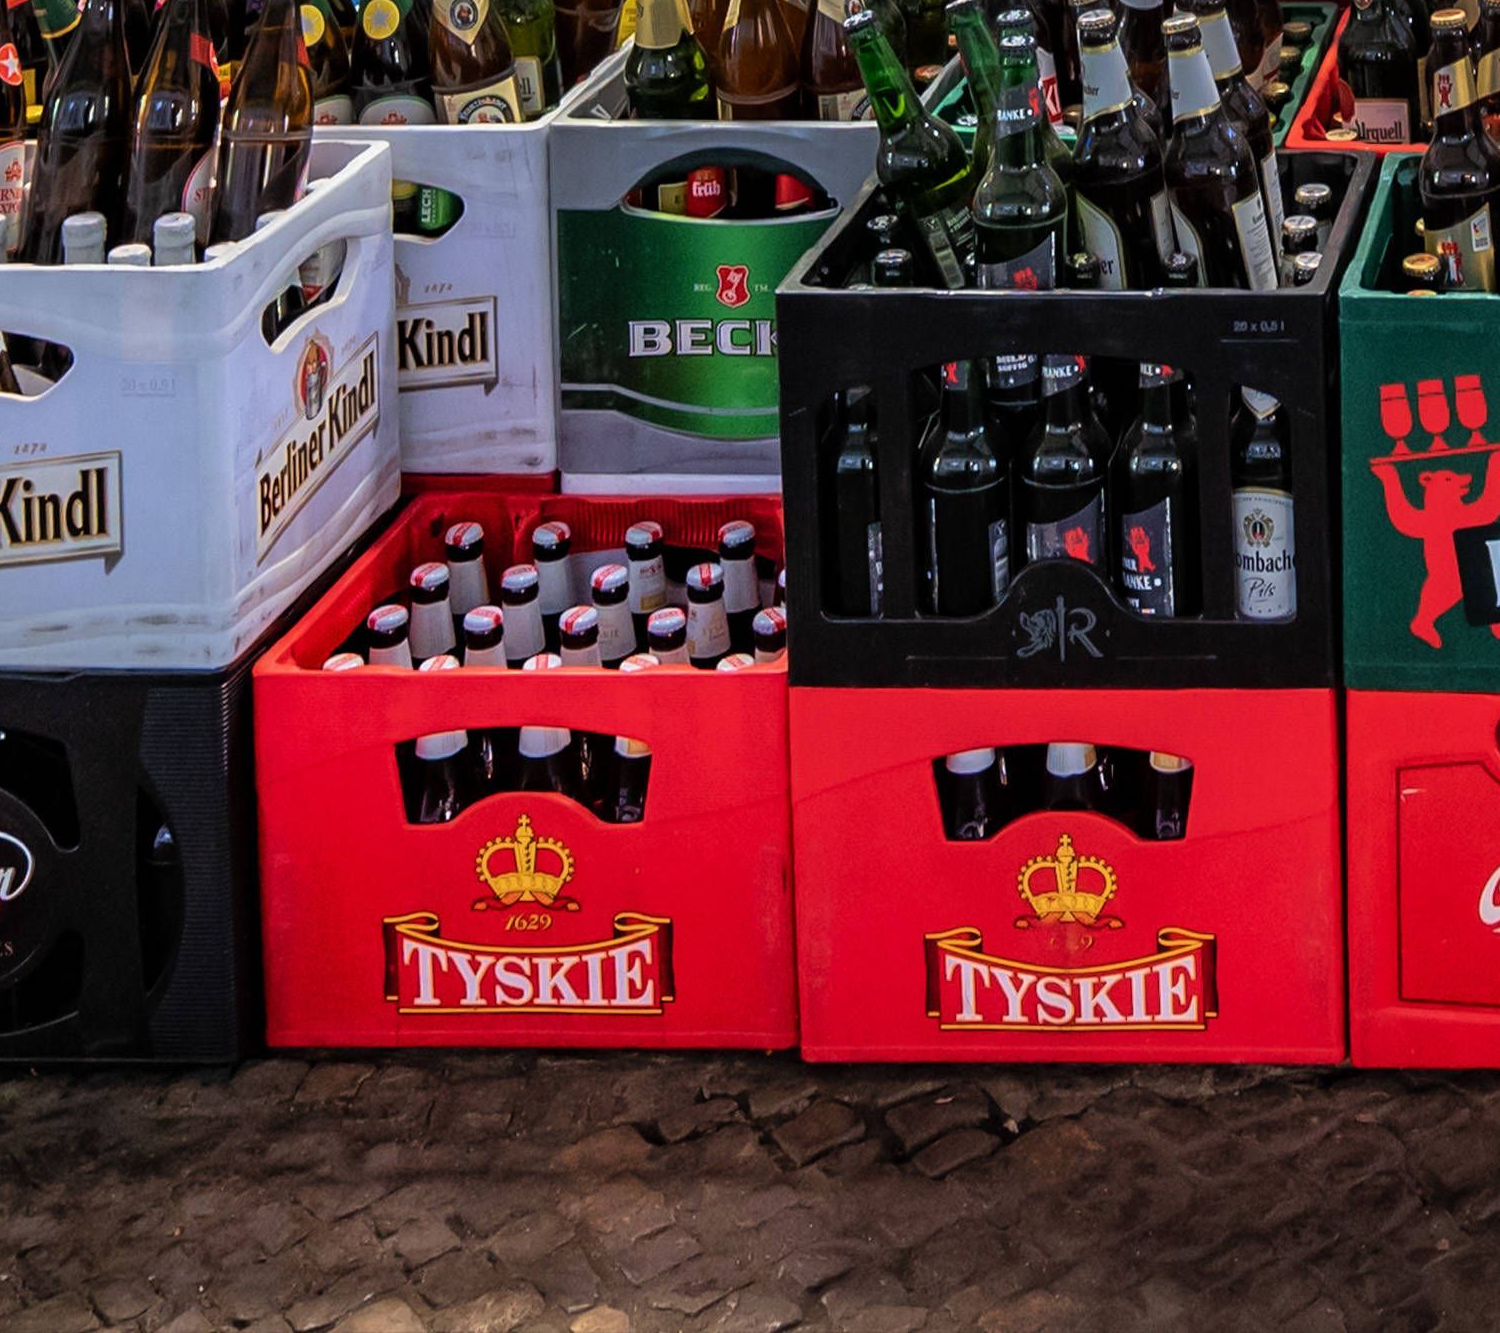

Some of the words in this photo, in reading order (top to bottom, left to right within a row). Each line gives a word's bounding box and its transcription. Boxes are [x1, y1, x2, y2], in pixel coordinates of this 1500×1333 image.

[420, 186, 432, 225] LECH
[691, 175, 722, 199] früh
[395, 311, 490, 373] Kindl
[257, 428, 325, 537] Berliner
[326, 367, 378, 459] Kindl
[1242, 579, 1276, 600] Pils
[503, 913, 552, 932] 1629
[402, 940, 656, 1009] TYSKIE
[943, 954, 1201, 1025] TYSKIE
